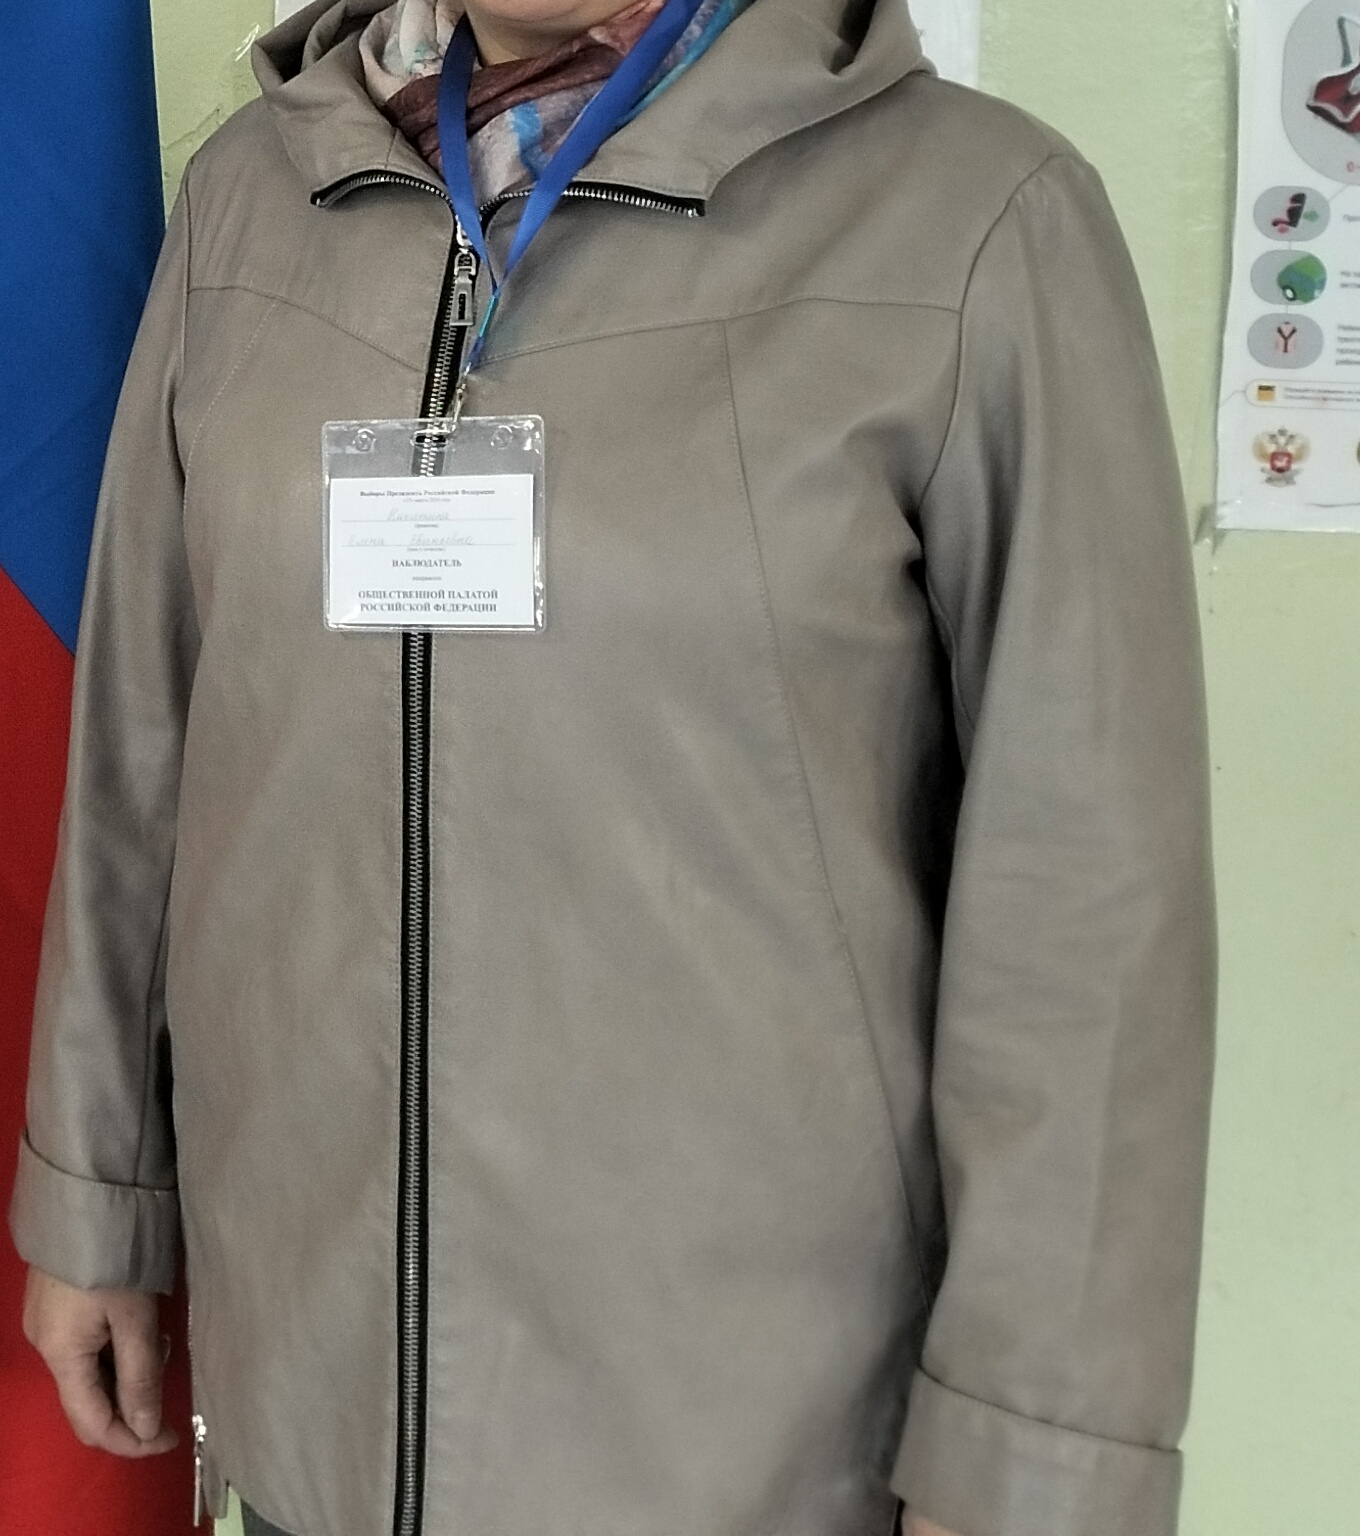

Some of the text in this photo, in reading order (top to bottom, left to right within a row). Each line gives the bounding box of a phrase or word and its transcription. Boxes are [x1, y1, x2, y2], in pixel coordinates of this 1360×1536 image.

[392, 559, 463, 568] НАБЛЮДАТЕЛЬ
[358, 588, 498, 600] ОБЩЕСТВЕННОЙ ПАЛАТОЙ
[360, 602, 498, 613] РОССИЙСКОЙ ФЕДЕРАЦИИ
